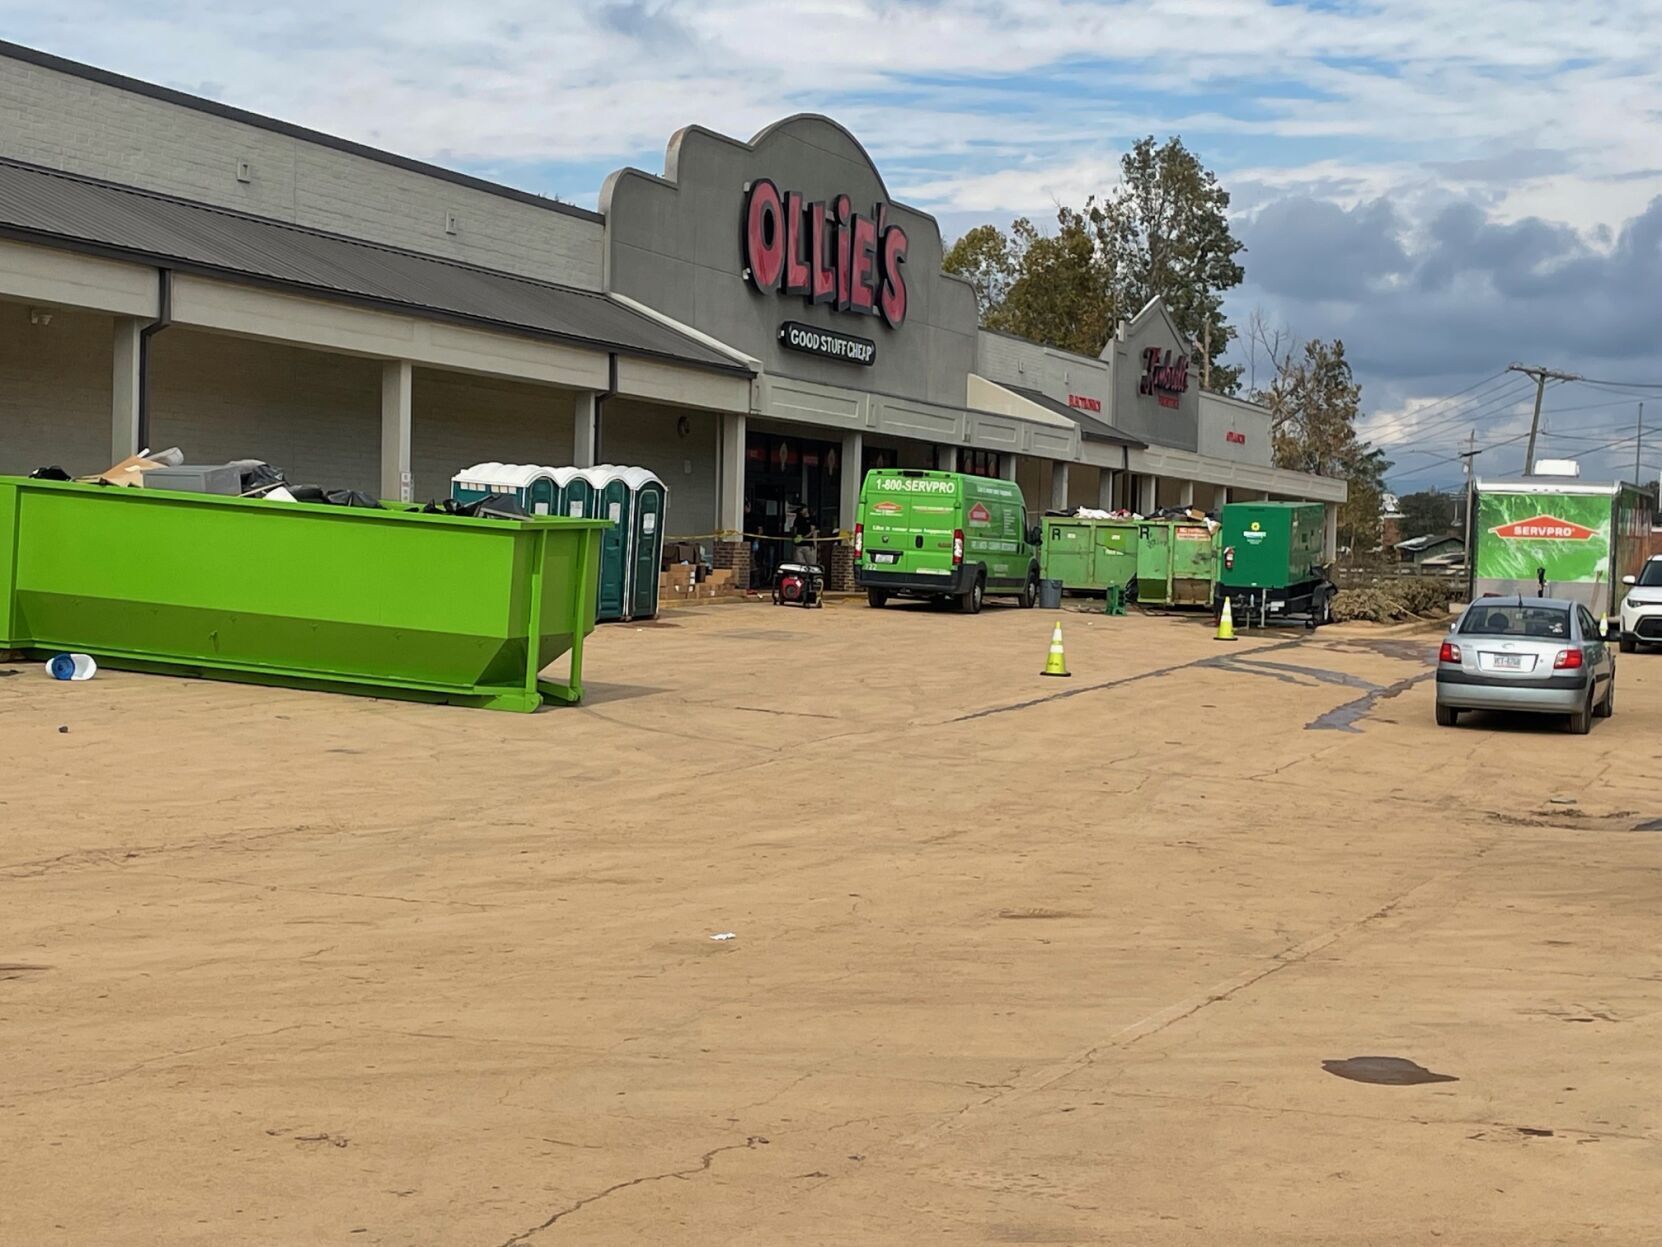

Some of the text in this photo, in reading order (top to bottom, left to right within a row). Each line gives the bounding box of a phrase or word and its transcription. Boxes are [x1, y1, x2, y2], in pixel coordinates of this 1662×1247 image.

[821, 336, 846, 356] STUFF
[876, 479, 955, 493] 1-800-SERVPRO
[1051, 528, 1061, 541] R
[1139, 526, 1150, 540] R
[1513, 526, 1572, 537] SERVPRO
